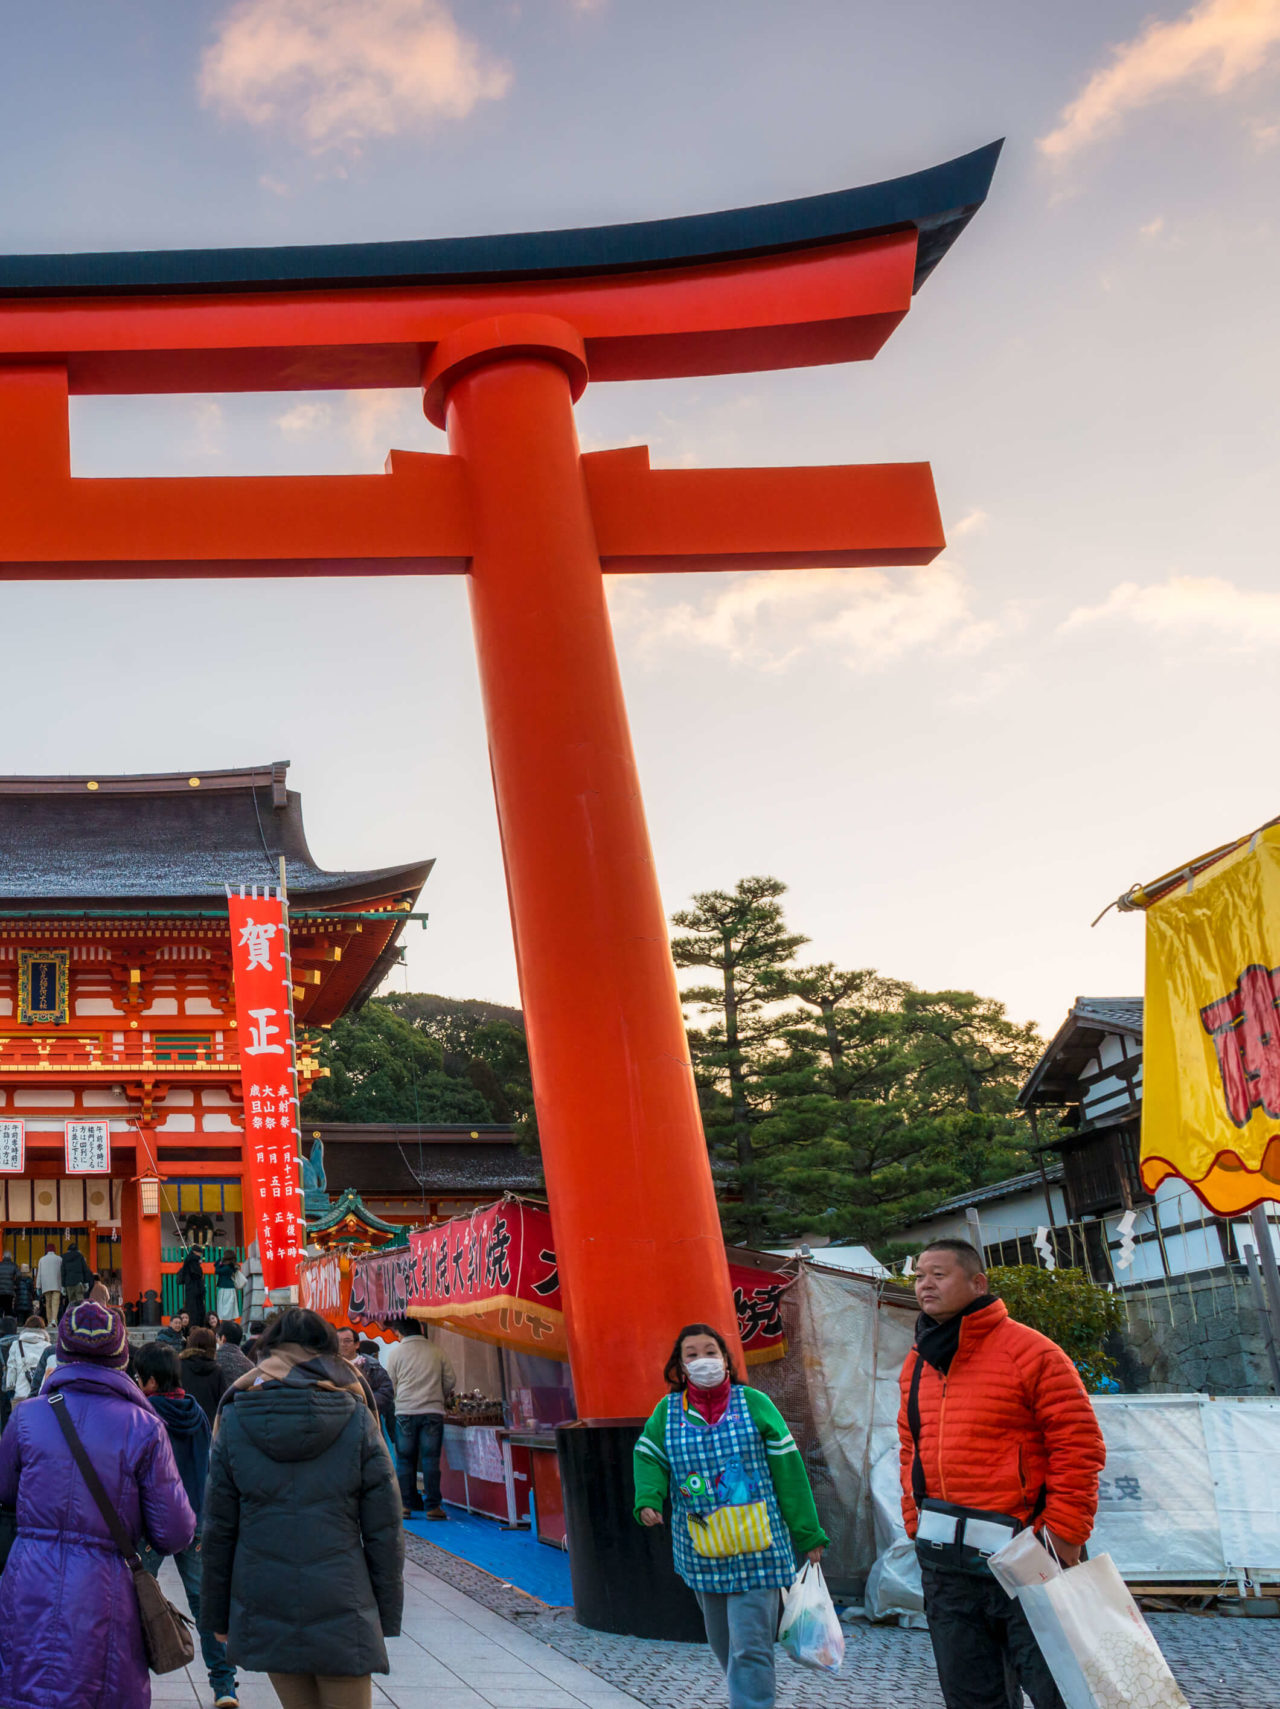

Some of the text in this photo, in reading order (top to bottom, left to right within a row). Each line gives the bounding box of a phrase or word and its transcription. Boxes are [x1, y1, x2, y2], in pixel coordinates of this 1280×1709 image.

[238, 918, 285, 1056] 賀正
[249, 1084, 263, 1129] 歳旦祭
[262, 1085, 277, 1129] 大山祭
[277, 1084, 290, 1128] 奉射祭
[286, 1212, 297, 1258] 午後一時
